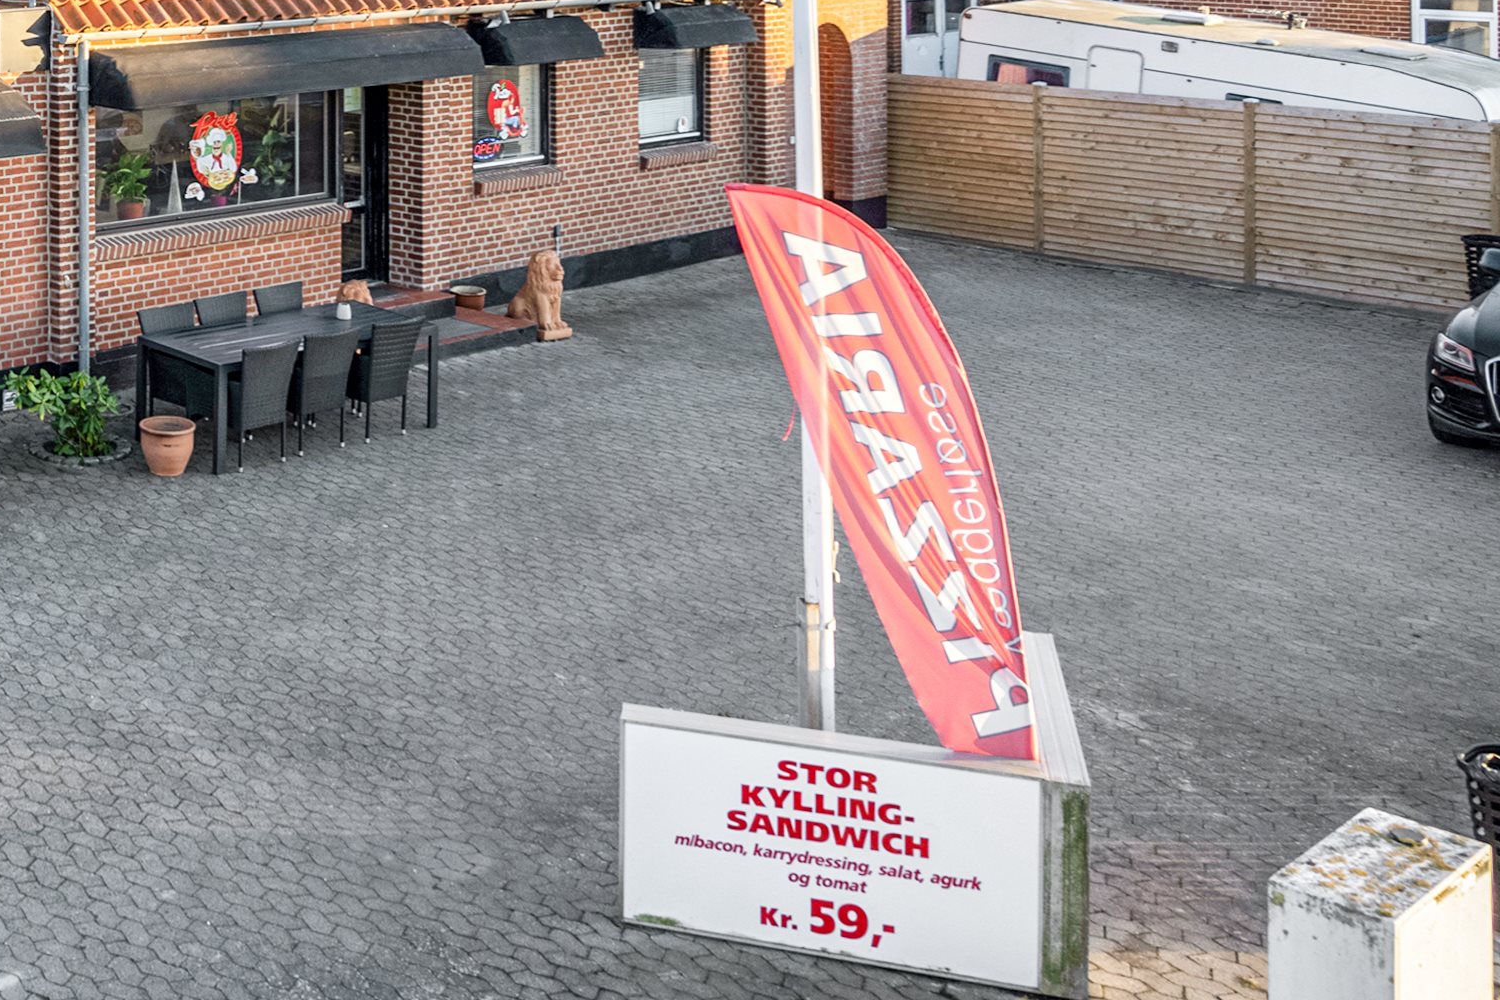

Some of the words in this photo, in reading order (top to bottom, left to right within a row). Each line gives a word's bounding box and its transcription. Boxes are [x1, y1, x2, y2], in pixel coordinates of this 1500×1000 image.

[473, 143, 501, 155] OPEN
[776, 759, 878, 794] STOR
[740, 783, 915, 826] KYLLING-
[726, 809, 930, 859] SANDWICH
[752, 843, 873, 877] karrydressing,
[878, 865, 924, 884] salat,
[930, 873, 982, 891] agurk
[787, 871, 811, 888] og
[815, 874, 868, 894] tomat
[759, 905, 799, 931] Kr.
[809, 897, 896, 949] 59,-
